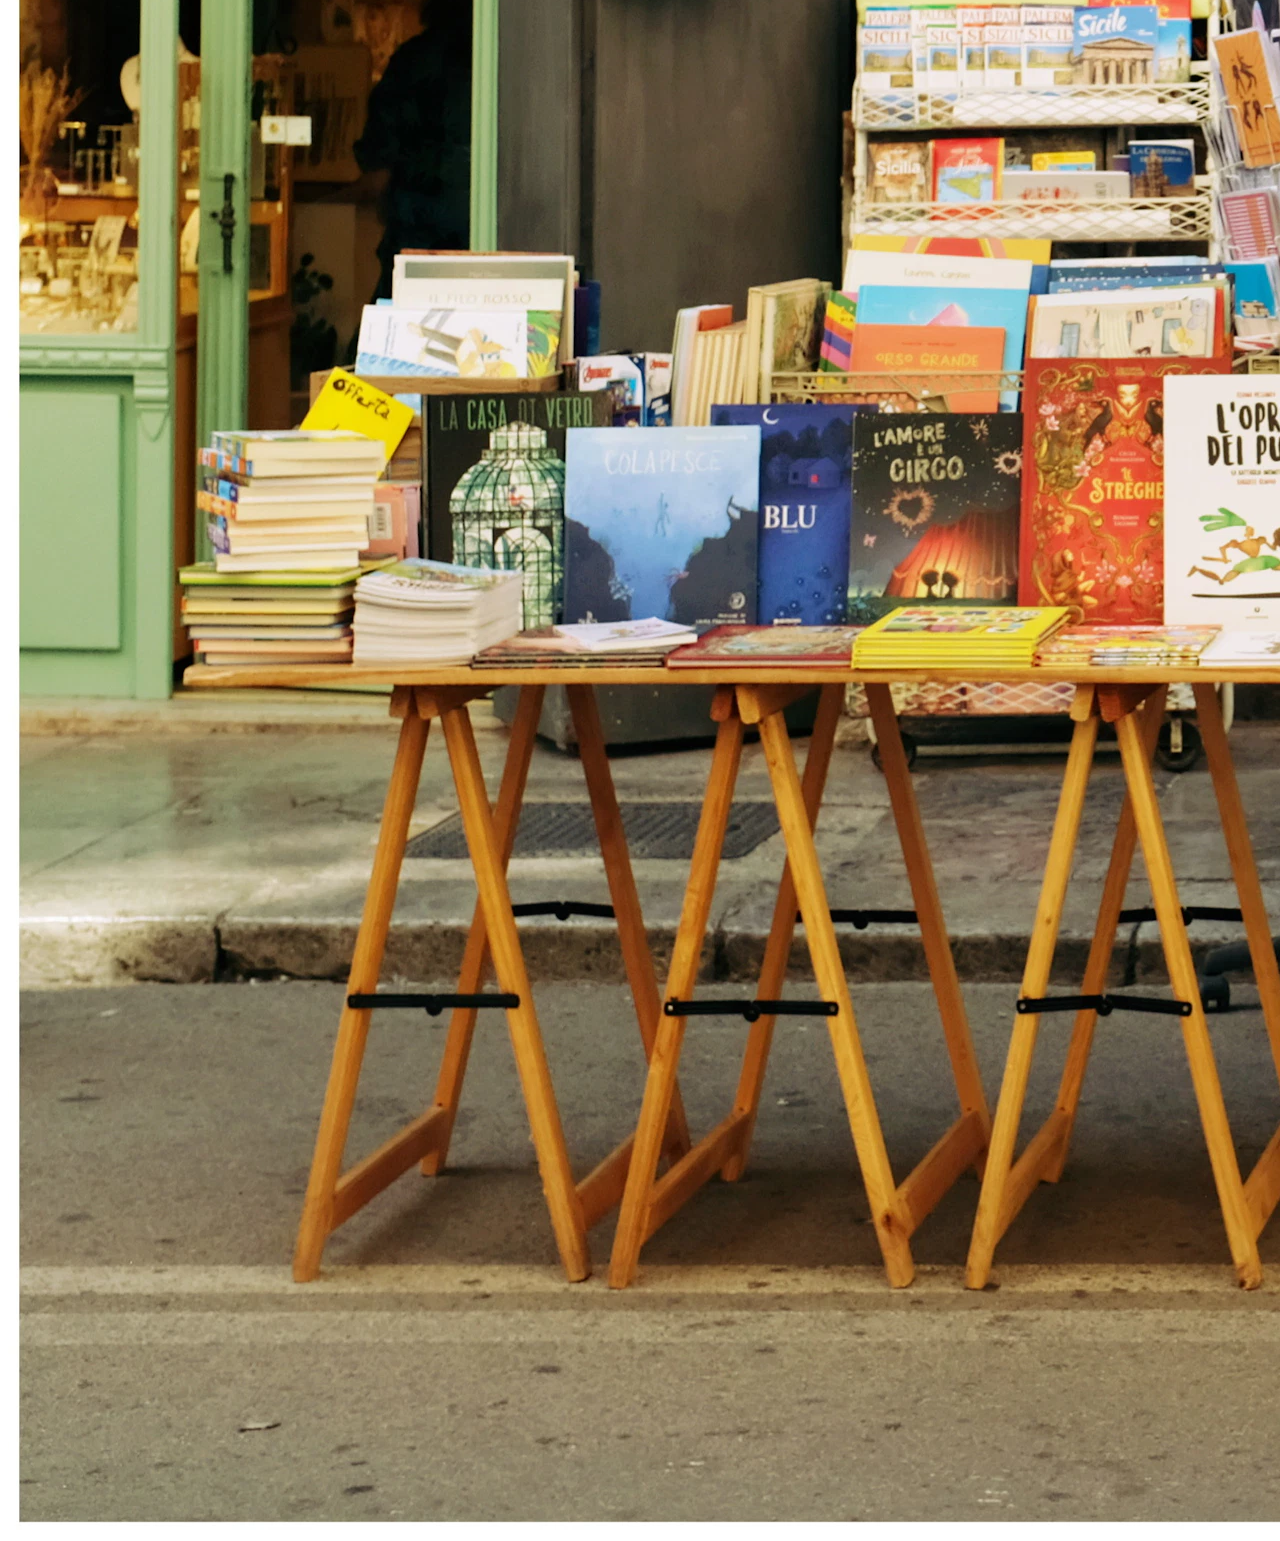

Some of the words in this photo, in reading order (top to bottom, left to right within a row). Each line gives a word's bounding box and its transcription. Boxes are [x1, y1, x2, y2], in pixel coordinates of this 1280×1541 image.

[1078, 7, 1127, 37] Sicile
[875, 160, 922, 176] Sicilia
[483, 292, 532, 305] ROSSO
[918, 352, 980, 368] GRANDE
[439, 400, 459, 431] LA
[466, 399, 507, 430] CASA
[544, 397, 594, 428] VETRO
[1206, 434, 1244, 466] DEI
[889, 455, 965, 484] CIRCO
[763, 504, 818, 529] BLU
